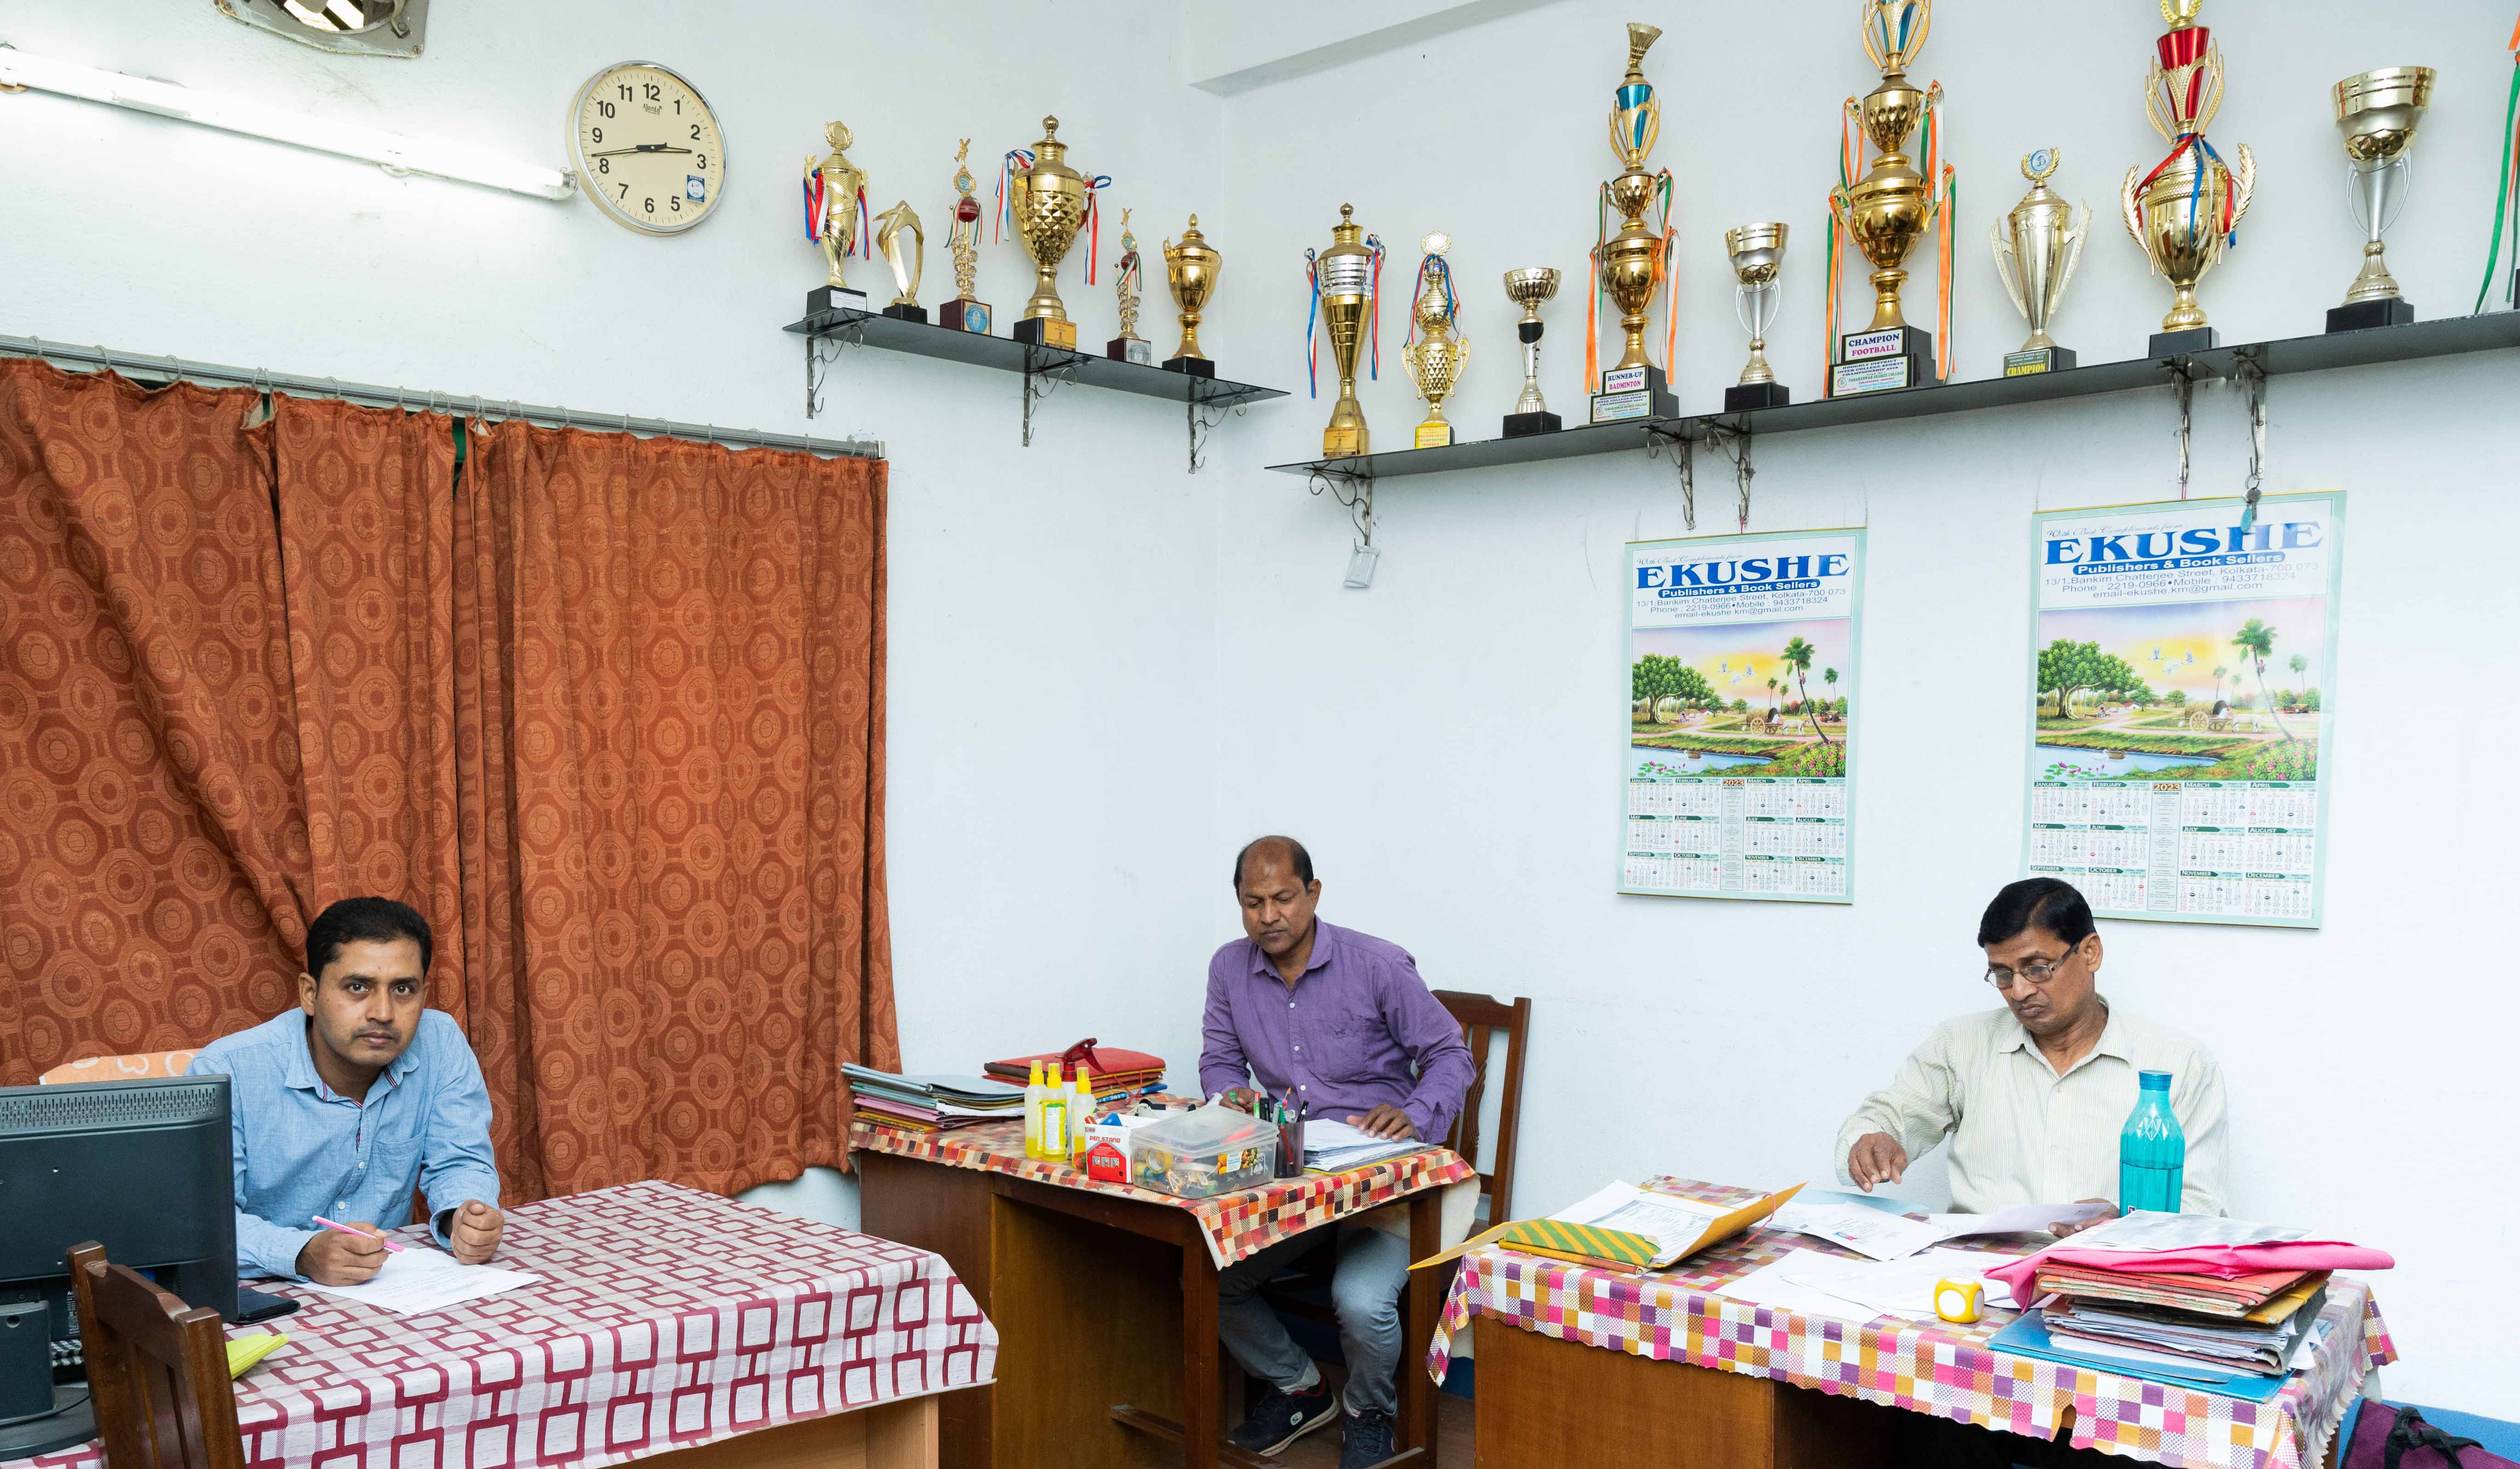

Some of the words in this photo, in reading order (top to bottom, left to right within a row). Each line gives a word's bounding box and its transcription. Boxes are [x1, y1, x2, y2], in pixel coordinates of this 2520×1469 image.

[618, 84, 633, 102] 11
[643, 83, 660, 102] 12
[597, 100, 615, 118] 10
[674, 100, 681, 115] 1
[592, 127, 602, 143] 9
[691, 125, 700, 141] 2
[599, 158, 609, 174] 8
[697, 154, 707, 170] 3
[619, 183, 629, 199] 7
[645, 198, 654, 213] 6
[670, 196, 681, 211] 5
[1849, 334, 1900, 347] CHAMPION
[1852, 344, 1896, 356] FOOTBALL
[1608, 371, 1643, 381] RUNNER-UP
[2007, 363, 2045, 376] CHAMPION
[1609, 381, 1640, 390] BADMINTON
[2044, 522, 2323, 564] EKUSHE
[1636, 554, 1850, 588] EKUSHE
[2078, 563, 2158, 574] Publishers
[2180, 557, 2221, 567] Book
[2226, 554, 2282, 564] Sellers
[2116, 572, 2173, 581] Chatterjee
[2221, 564, 2292, 575] Kolkata-700
[1663, 588, 1725, 597] Publishers
[1741, 584, 1772, 592] Book
[1776, 581, 1817, 590] Sellers
[2107, 581, 2166, 590] 2219-0966
[1686, 603, 1731, 611] 2219-0966
[1773, 597, 1827, 606] 9433718324
[1692, 596, 1736, 604] Chatterjee
[1772, 590, 1825, 598] Kolkata-700
